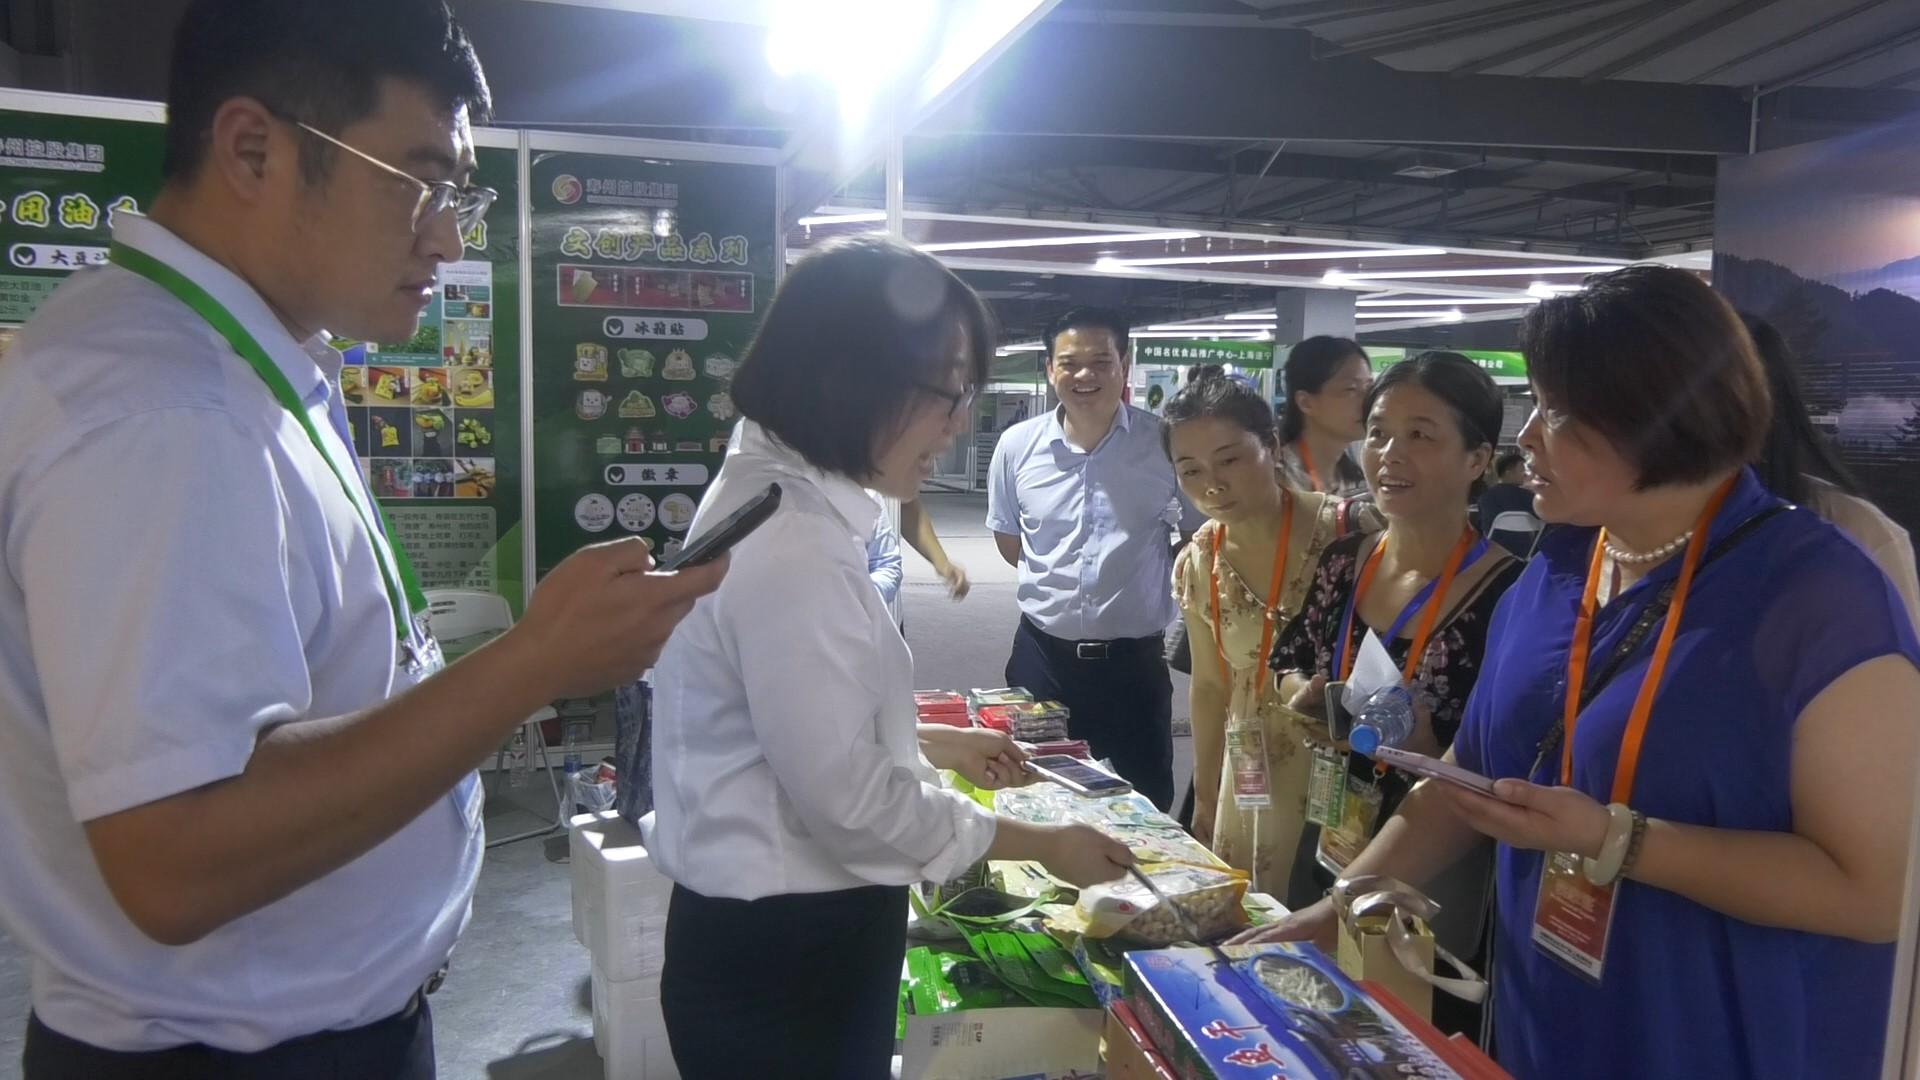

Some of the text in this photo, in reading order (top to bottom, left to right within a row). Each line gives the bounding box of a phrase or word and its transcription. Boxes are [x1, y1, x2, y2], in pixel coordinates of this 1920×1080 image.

[0, 138, 105, 161] 州控股集团
[560, 226, 749, 266] 文创产品系列
[634, 320, 685, 336] 冰箱贴
[641, 466, 680, 482] 徽章
